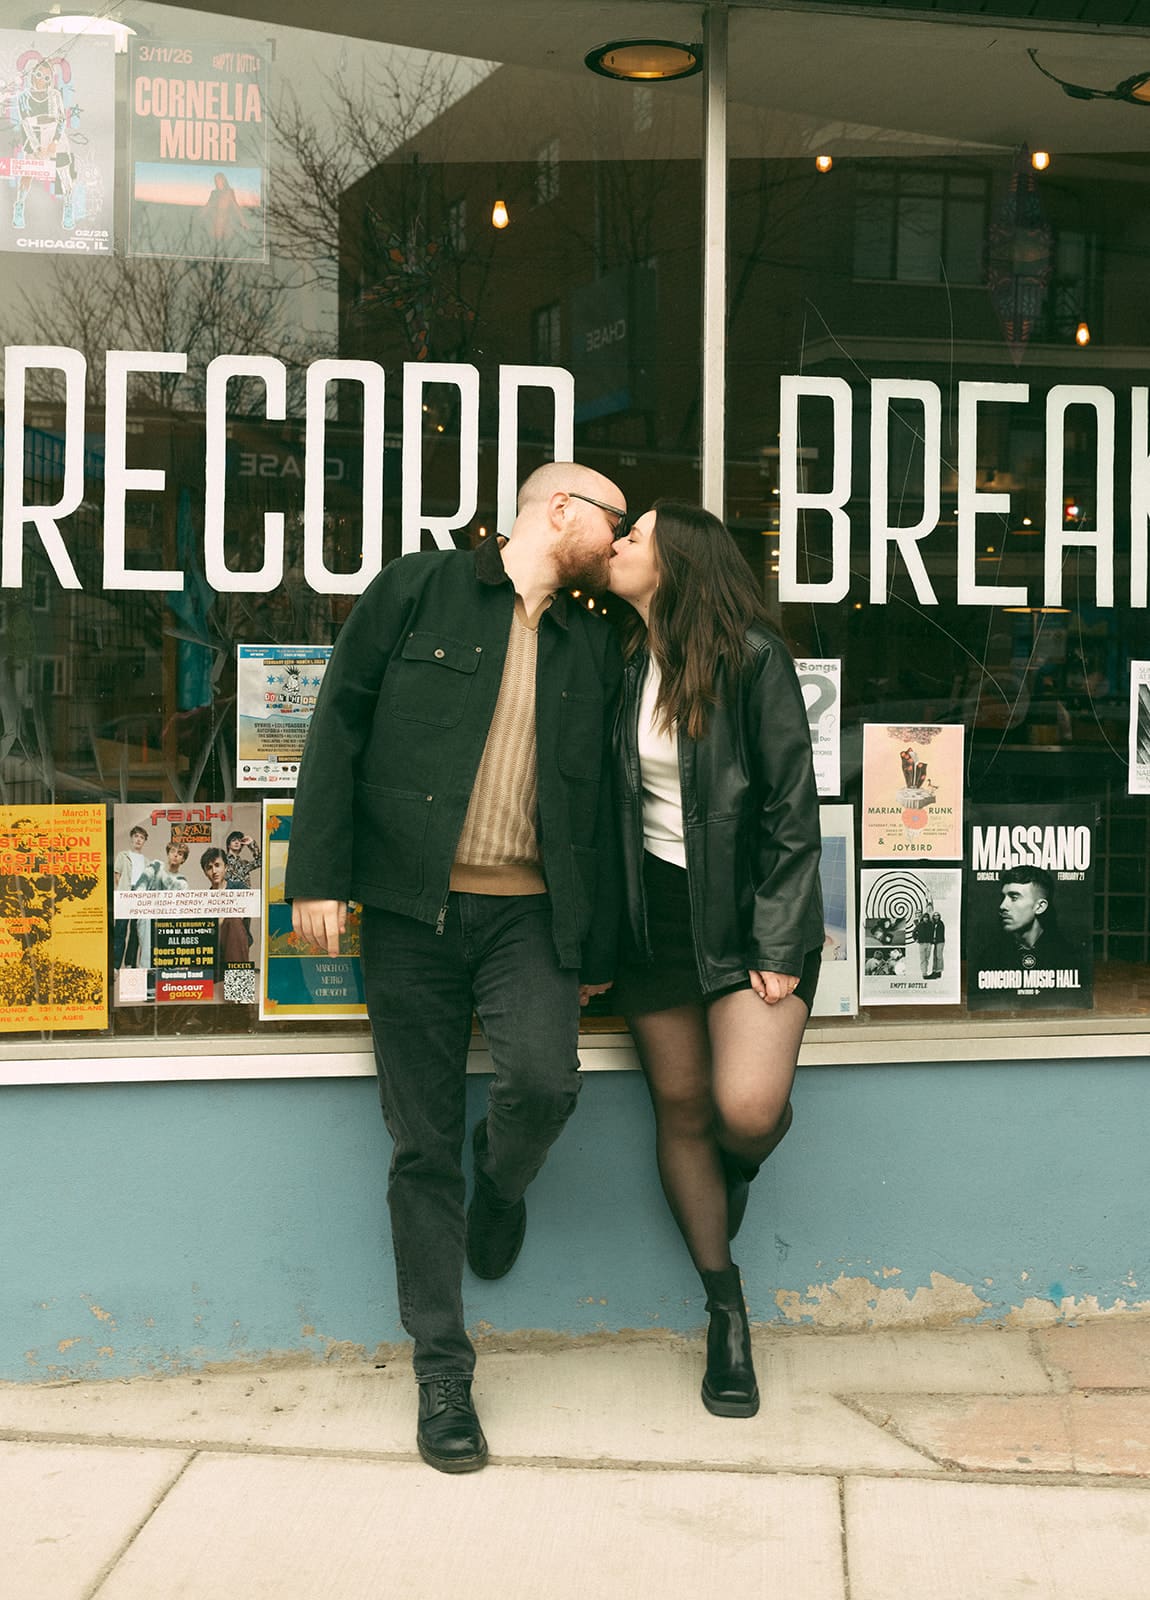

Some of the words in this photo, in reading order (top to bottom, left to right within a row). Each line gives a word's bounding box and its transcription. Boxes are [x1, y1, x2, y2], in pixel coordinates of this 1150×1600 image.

[138, 46, 193, 64] 3/11/26
[135, 76, 262, 122] CORNELIA
[159, 119, 237, 162] MURR
[75, 230, 109, 238] 02/28
[16, 238, 90, 252] CHICAGO,
[94, 240, 109, 251] IL
[1, 345, 575, 594] RECORD
[799, 662, 838, 673] Songs
[62, 809, 89, 817] March
[92, 809, 102, 817] 14
[972, 825, 1091, 871] MASSANO
[0, 853, 37, 864] OST
[44, 851, 102, 863] THERE
[39, 863, 100, 874] REALLY
[168, 937, 180, 945] ALL
[180, 937, 199, 945] AGES
[153, 947, 175, 956] Doors
[176, 947, 195, 956] Open
[202, 946, 214, 955] PM
[153, 957, 174, 966] Show
[179, 957, 191, 965] PM
[202, 956, 214, 965] PM
[978, 969, 1022, 989] CONCORD
[1023, 969, 1055, 989] MUSIC
[1056, 969, 1081, 988] HALL
[161, 983, 204, 991] dinosaur
[169, 990, 203, 1000] galaxy
